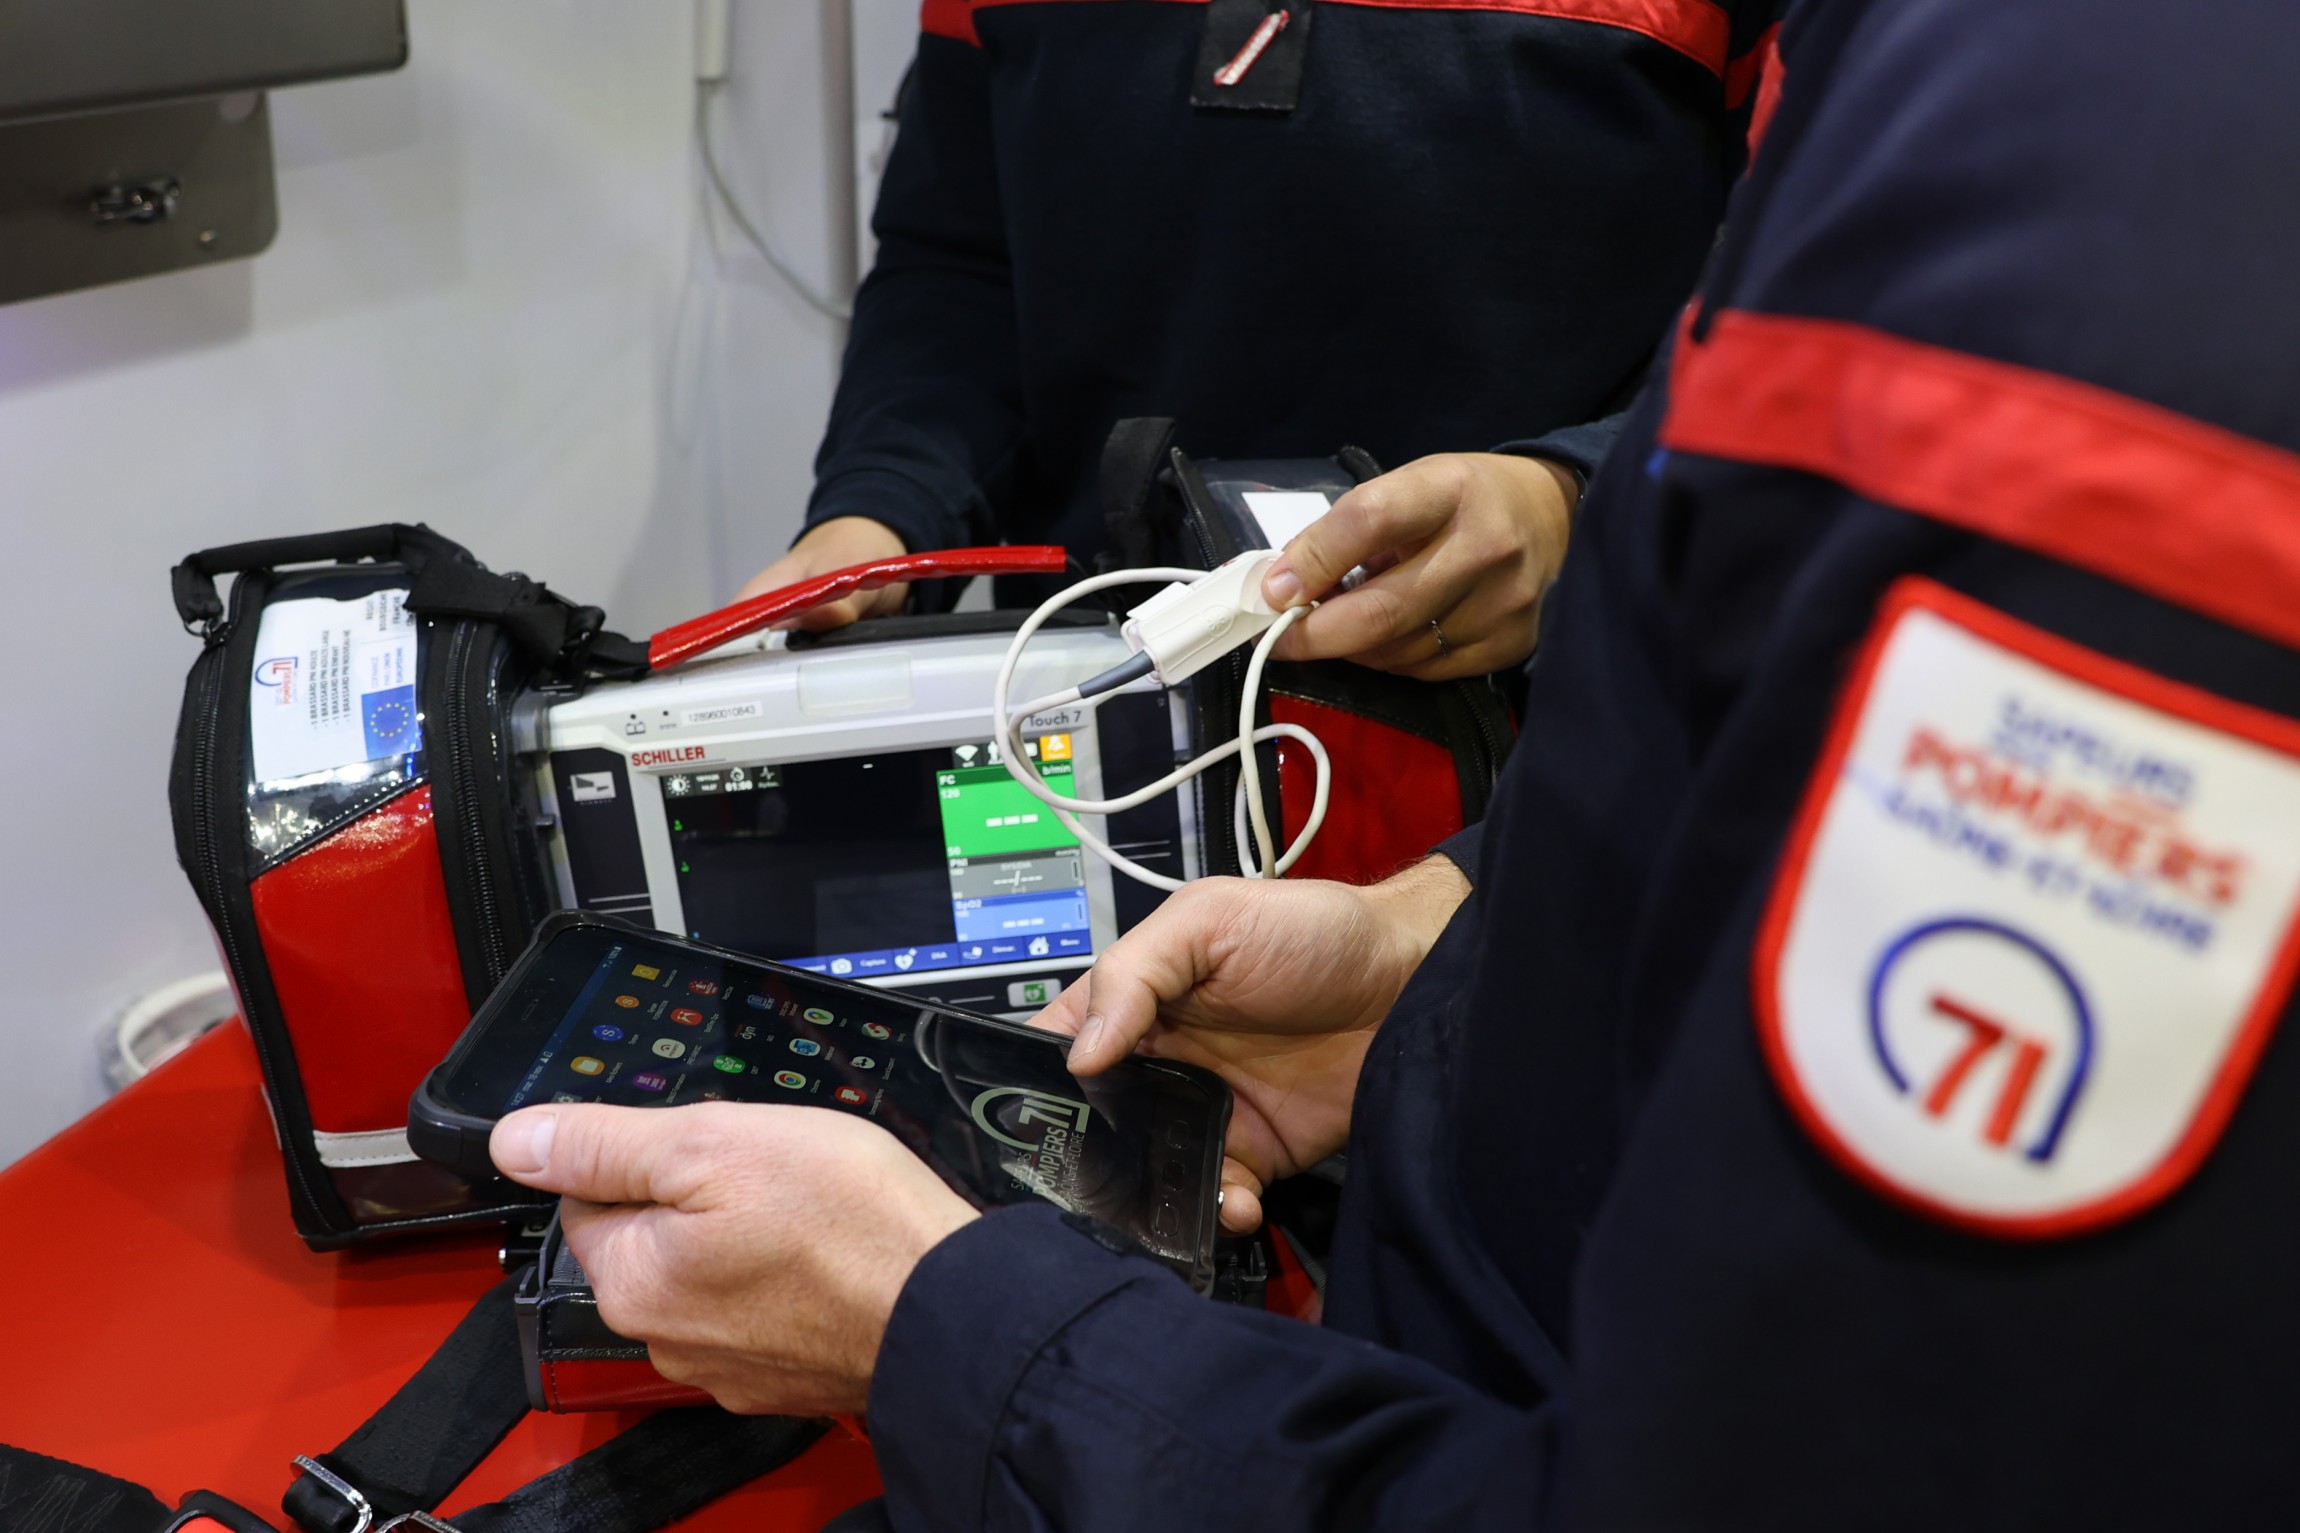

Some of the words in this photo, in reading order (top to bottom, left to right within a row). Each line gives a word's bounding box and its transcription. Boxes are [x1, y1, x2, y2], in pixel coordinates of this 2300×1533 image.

[272, 661, 291, 675] 71
[310, 682, 318, 719] BRASSARD
[320, 681, 328, 717] BRASSARD
[331, 678, 339, 715] BRASSARD
[342, 676, 350, 712] BRASSARD
[1028, 711, 1069, 728] Touch
[1074, 710, 1082, 723] 7
[631, 746, 706, 766] SCHILLER
[1905, 729, 2247, 908] POMPIERS
[1928, 994, 2049, 1148] 71
[1018, 1098, 1073, 1129] 71
[1032, 1126, 1068, 1196] POMPIERS
